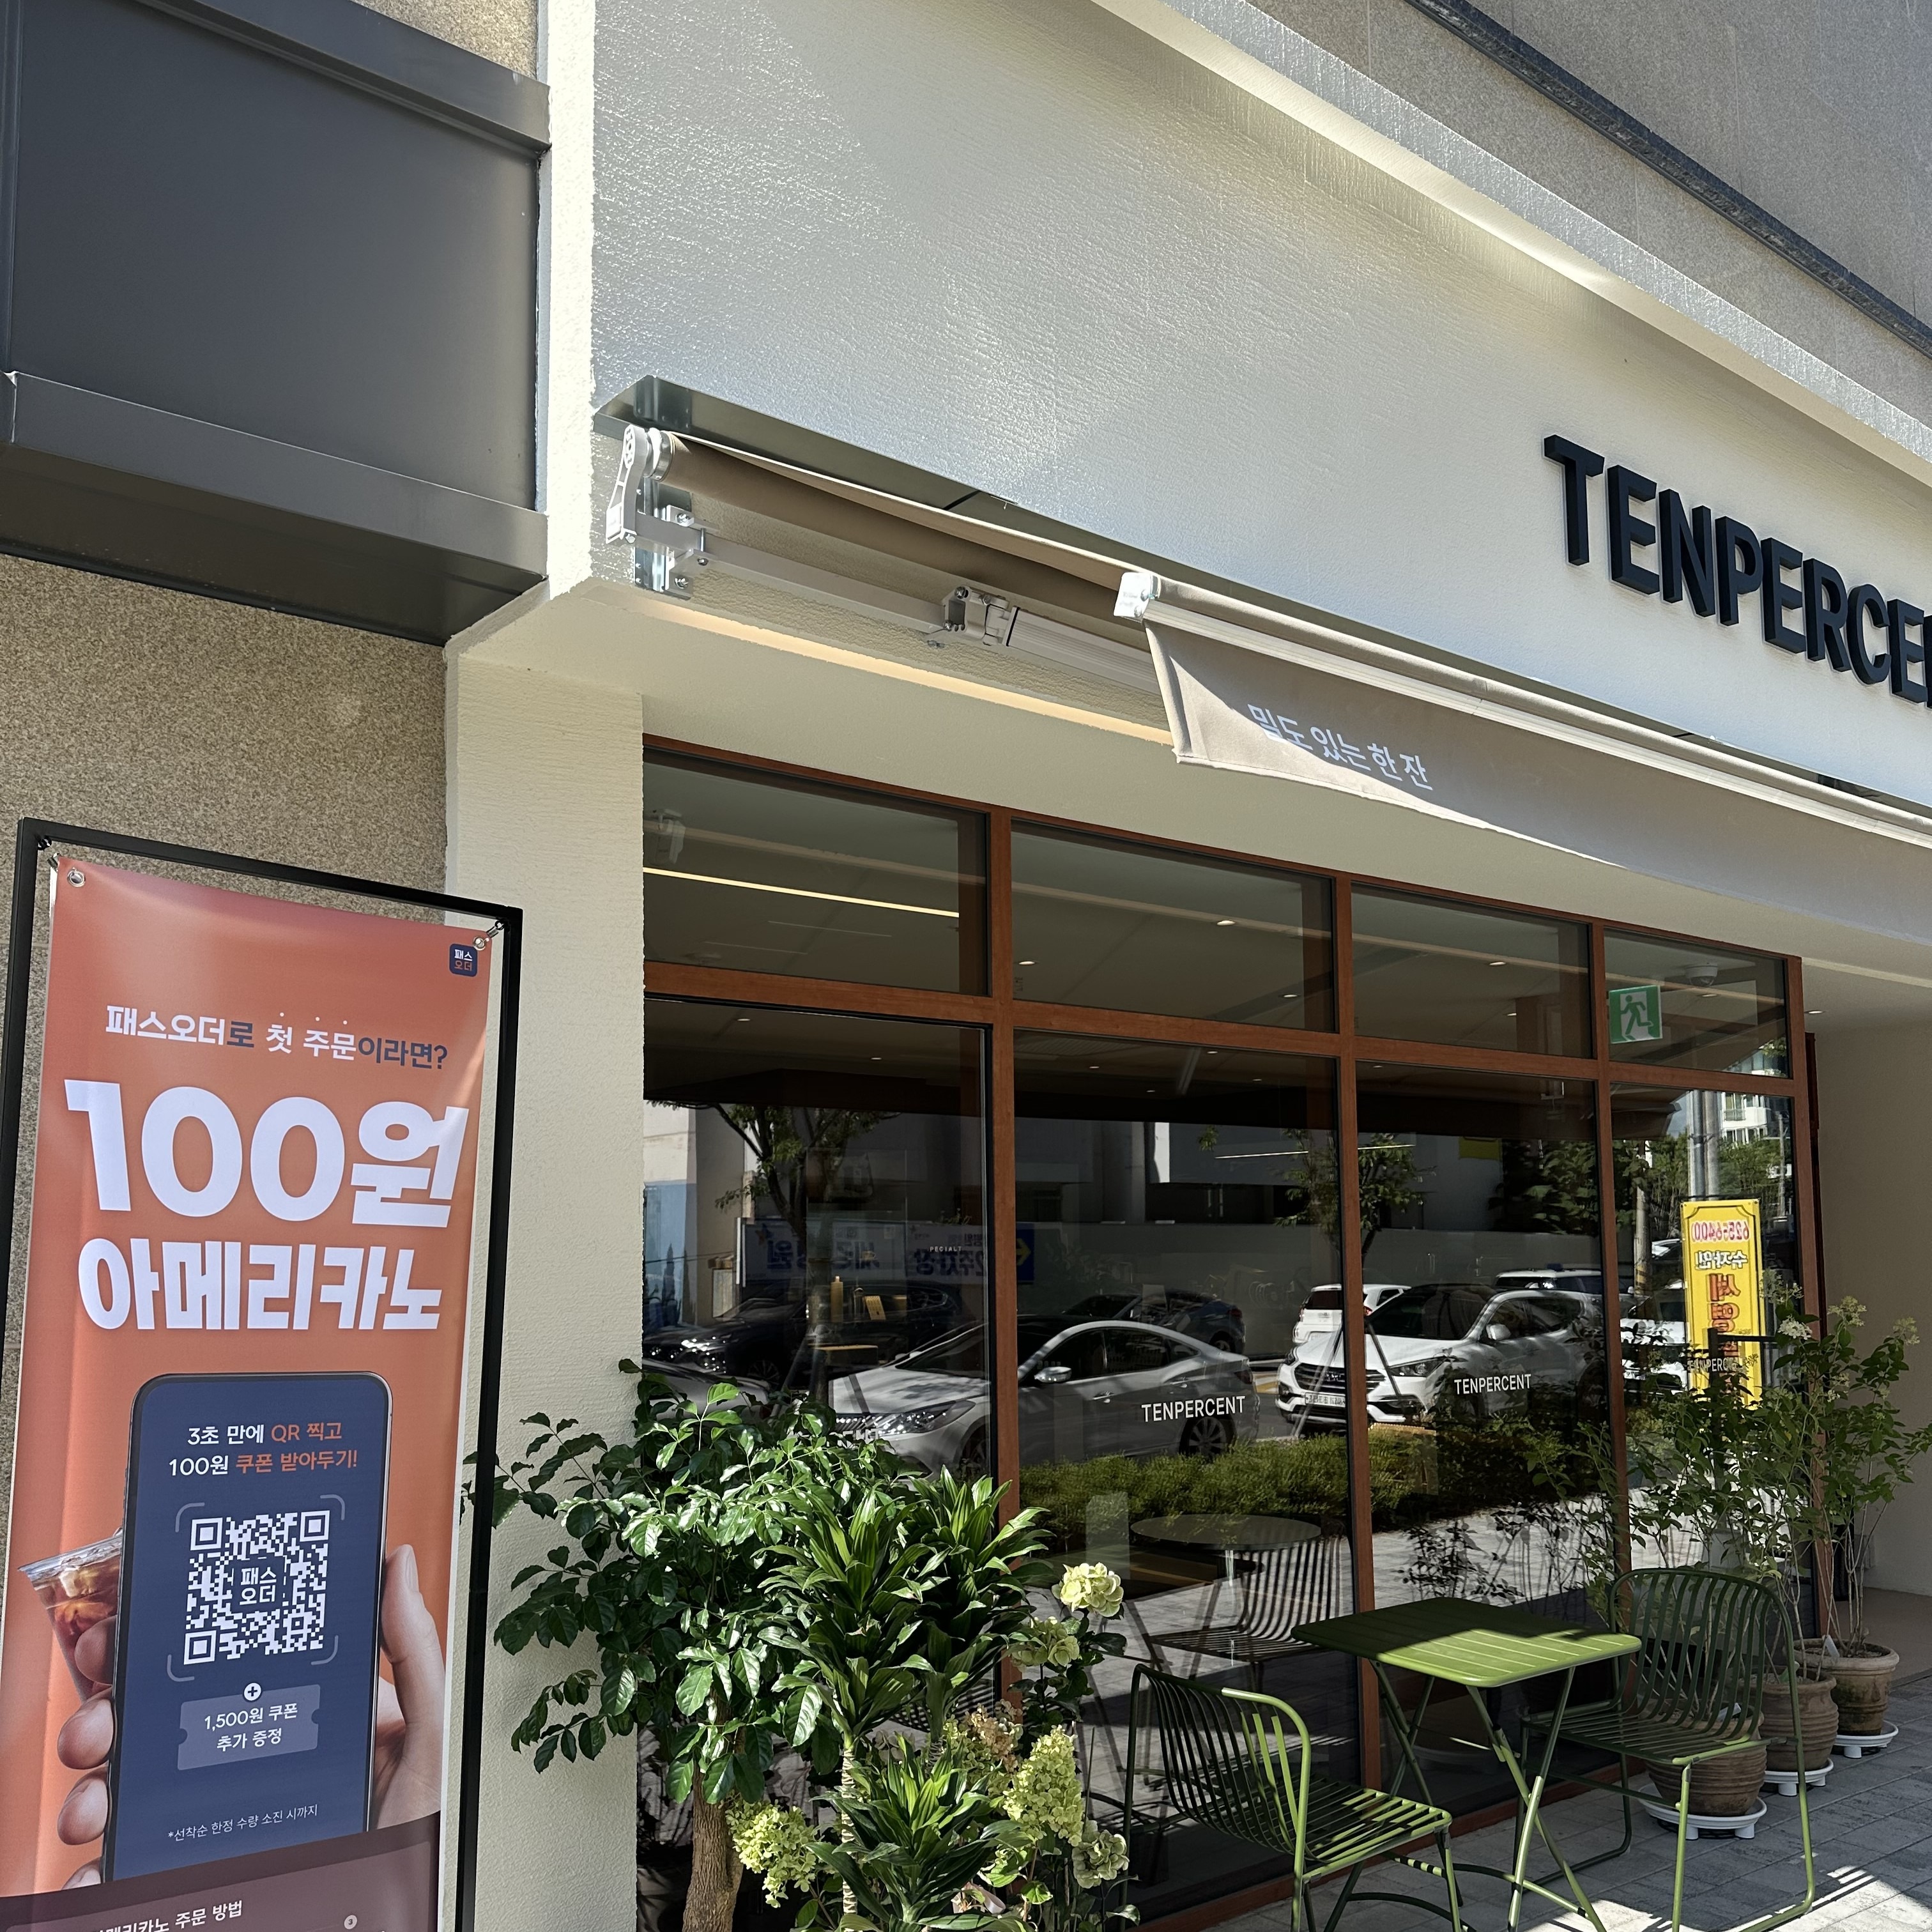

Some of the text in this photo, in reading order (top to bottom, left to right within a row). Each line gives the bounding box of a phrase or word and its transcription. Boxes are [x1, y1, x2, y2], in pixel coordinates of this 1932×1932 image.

[1544, 434, 1932, 709] TENPERCE
[1247, 703, 1434, 791] 밀도 있는 한 잔
[454, 949, 473, 962] 패스
[454, 960, 473, 971] 오더
[105, 1004, 448, 1070] 패스오더로 첫 주문이라면?
[63, 1078, 470, 1228] 100원
[77, 1237, 443, 1331] 아메리카노
[1453, 1373, 1532, 1395] TENPERCENT
[1141, 1395, 1246, 1422] TENPERCENT
[187, 1422, 342, 1446] 3초 만에 QR 찍고
[169, 1450, 358, 1476] 100원 쿠폰 받아두기!
[240, 1567, 277, 1585] 패스
[239, 1584, 276, 1606] 오더
[204, 1702, 298, 1731] 1,500원 쿠폰
[217, 1728, 282, 1752] 추가 증정
[211, 1819, 233, 1835] 한정
[236, 1814, 259, 1830] 수량
[261, 1809, 283, 1825] 소진
[286, 1804, 318, 1821] 시까지
[174, 1907, 207, 1929] 주문
[212, 1899, 243, 1922] 방법
